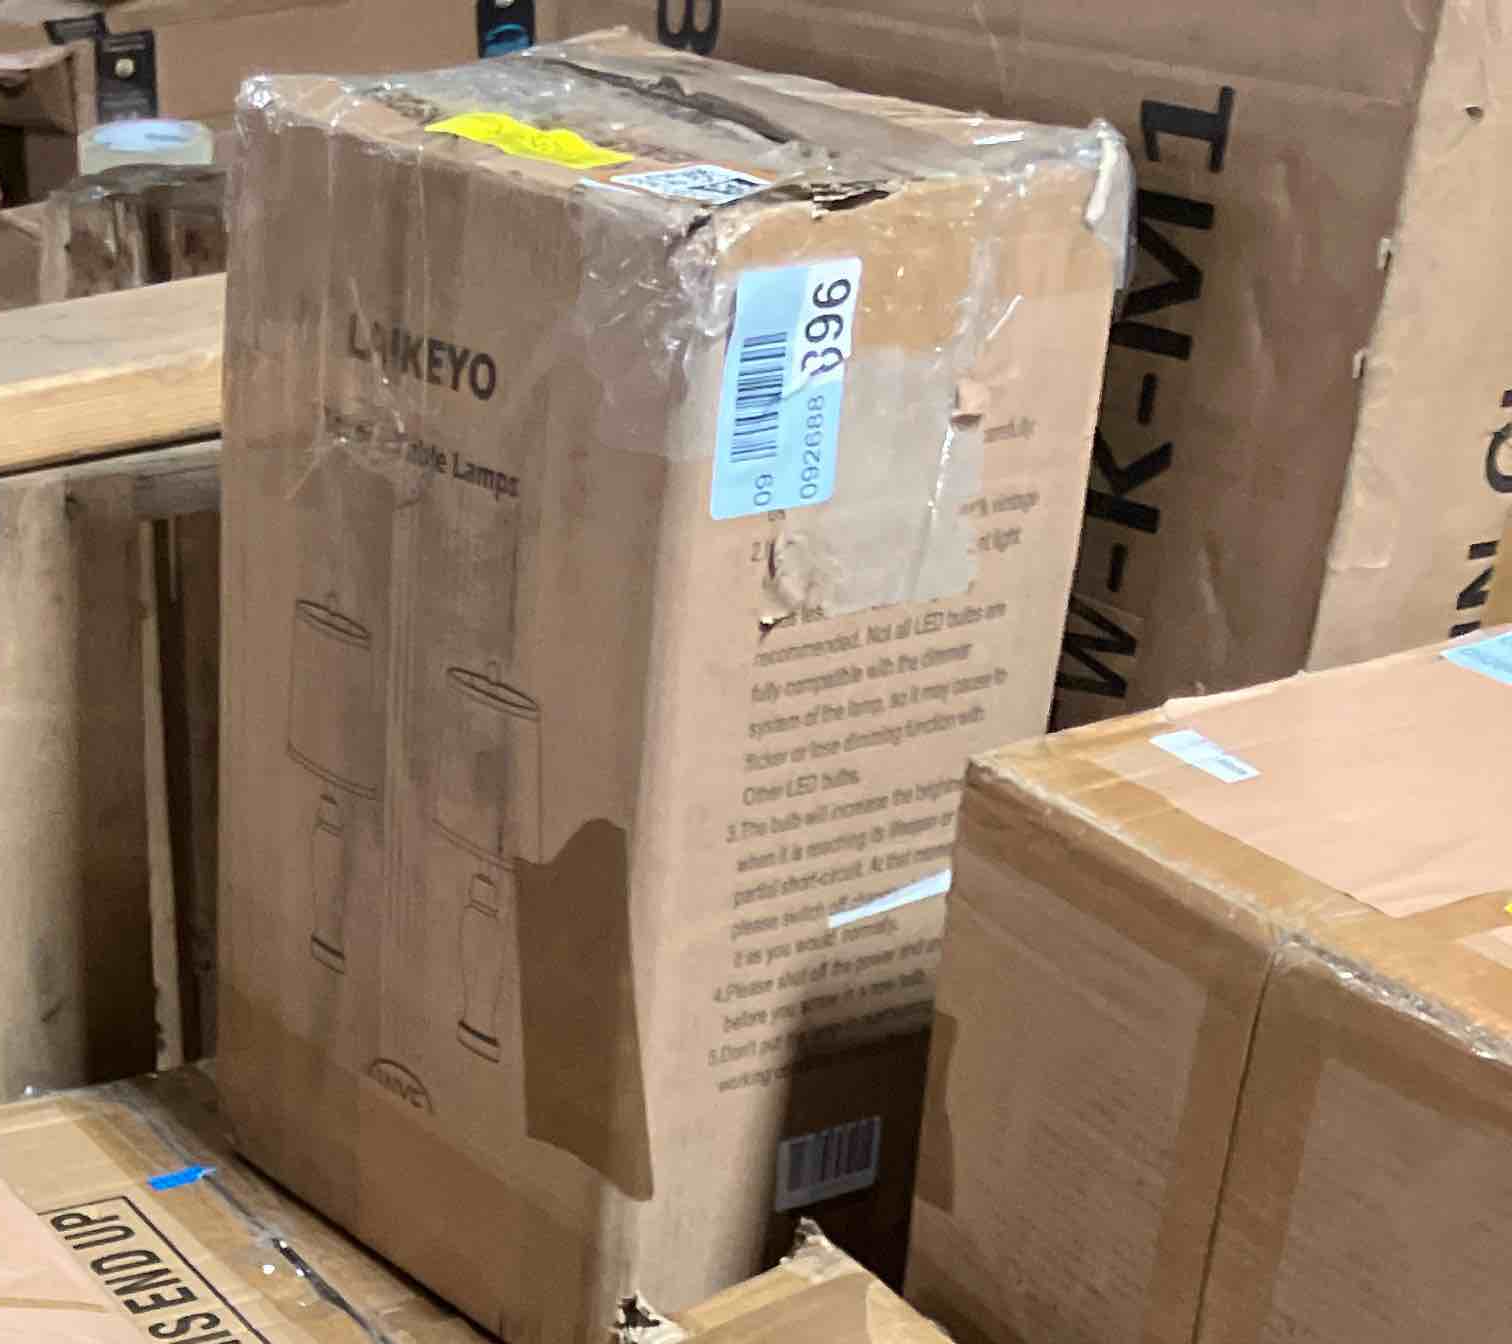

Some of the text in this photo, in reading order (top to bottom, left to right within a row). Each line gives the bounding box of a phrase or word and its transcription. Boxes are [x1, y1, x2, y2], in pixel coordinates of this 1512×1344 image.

[799, 395, 826, 500] 092688
[752, 474, 775, 507] 09
[49, 1211, 136, 1251] UP
[90, 1249, 199, 1315] END
